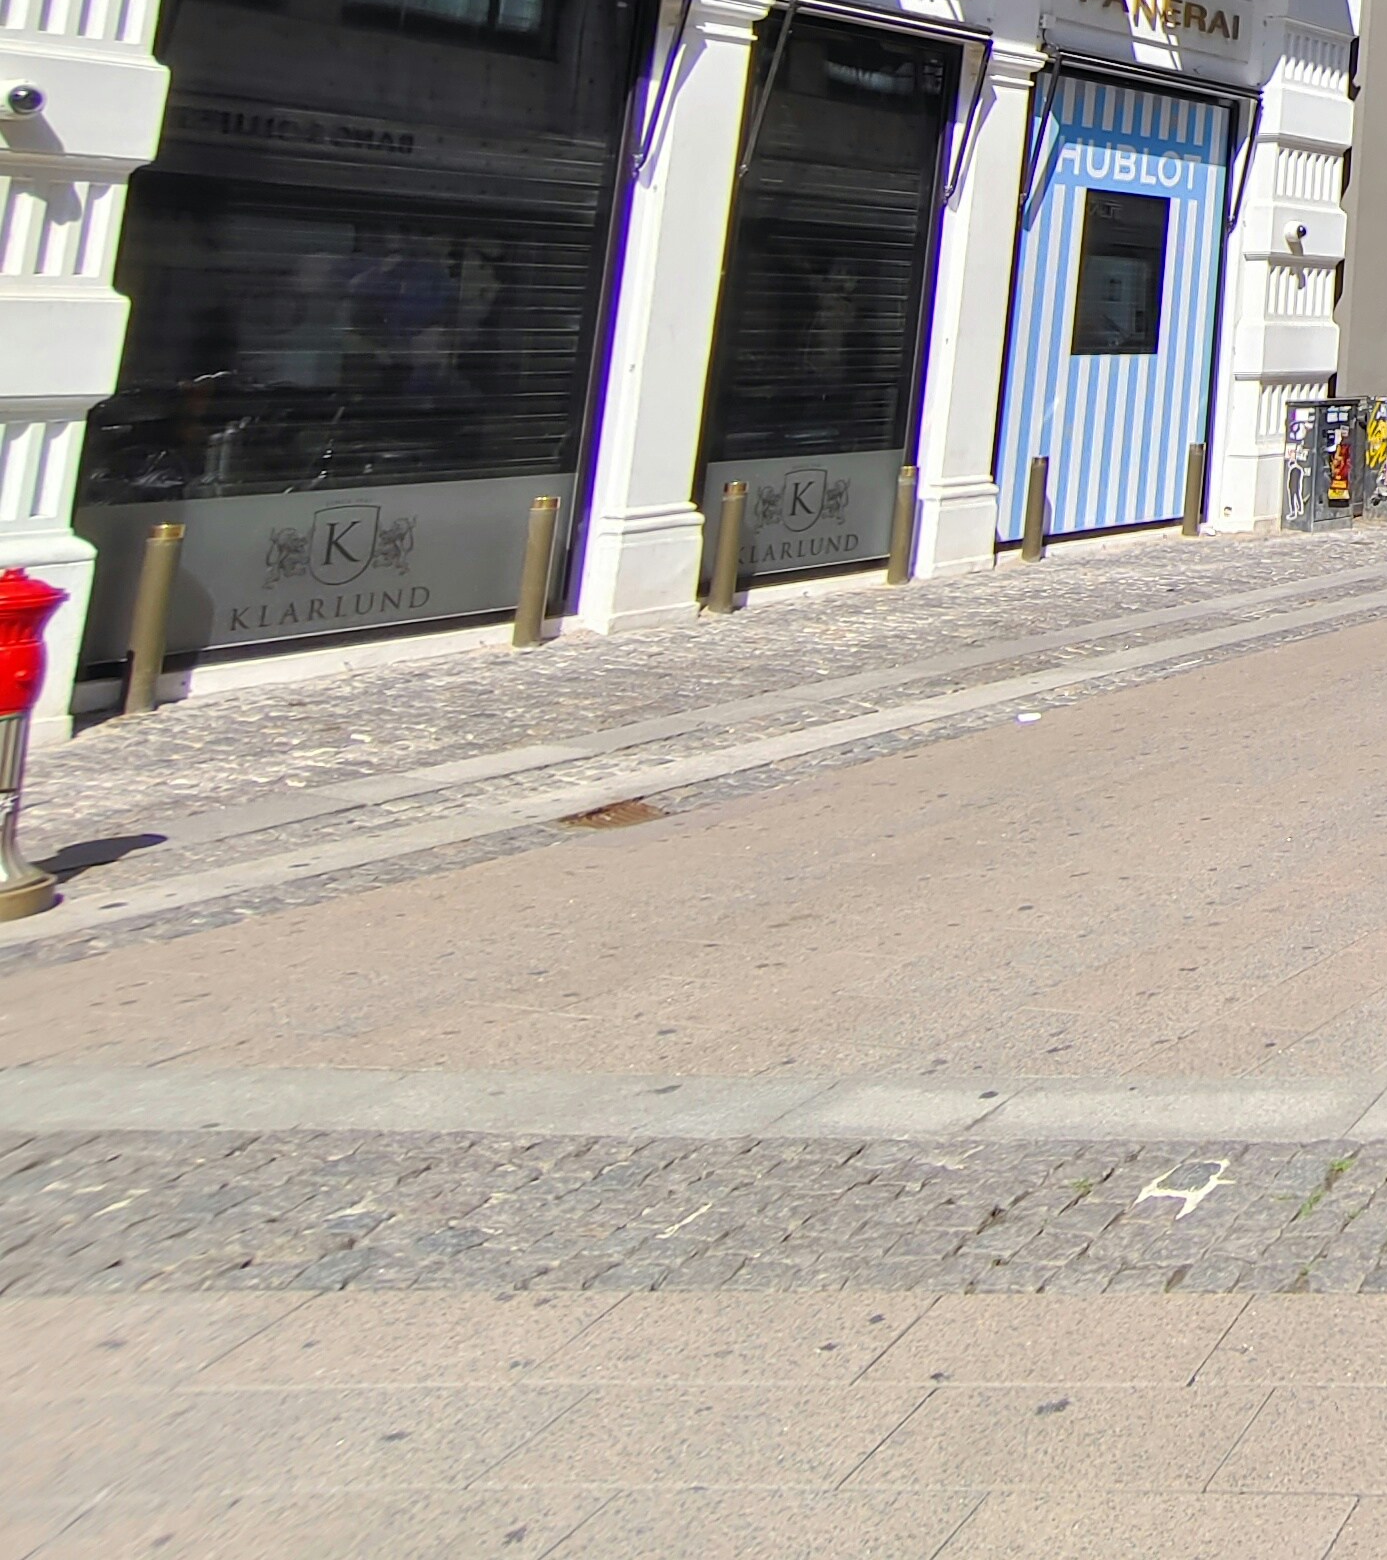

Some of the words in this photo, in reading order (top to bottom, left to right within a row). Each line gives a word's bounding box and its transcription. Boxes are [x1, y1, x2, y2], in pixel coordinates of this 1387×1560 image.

[1054, 134, 1202, 191] HUBLOT
[320, 520, 361, 567] K
[229, 586, 431, 632] KLARLUND
